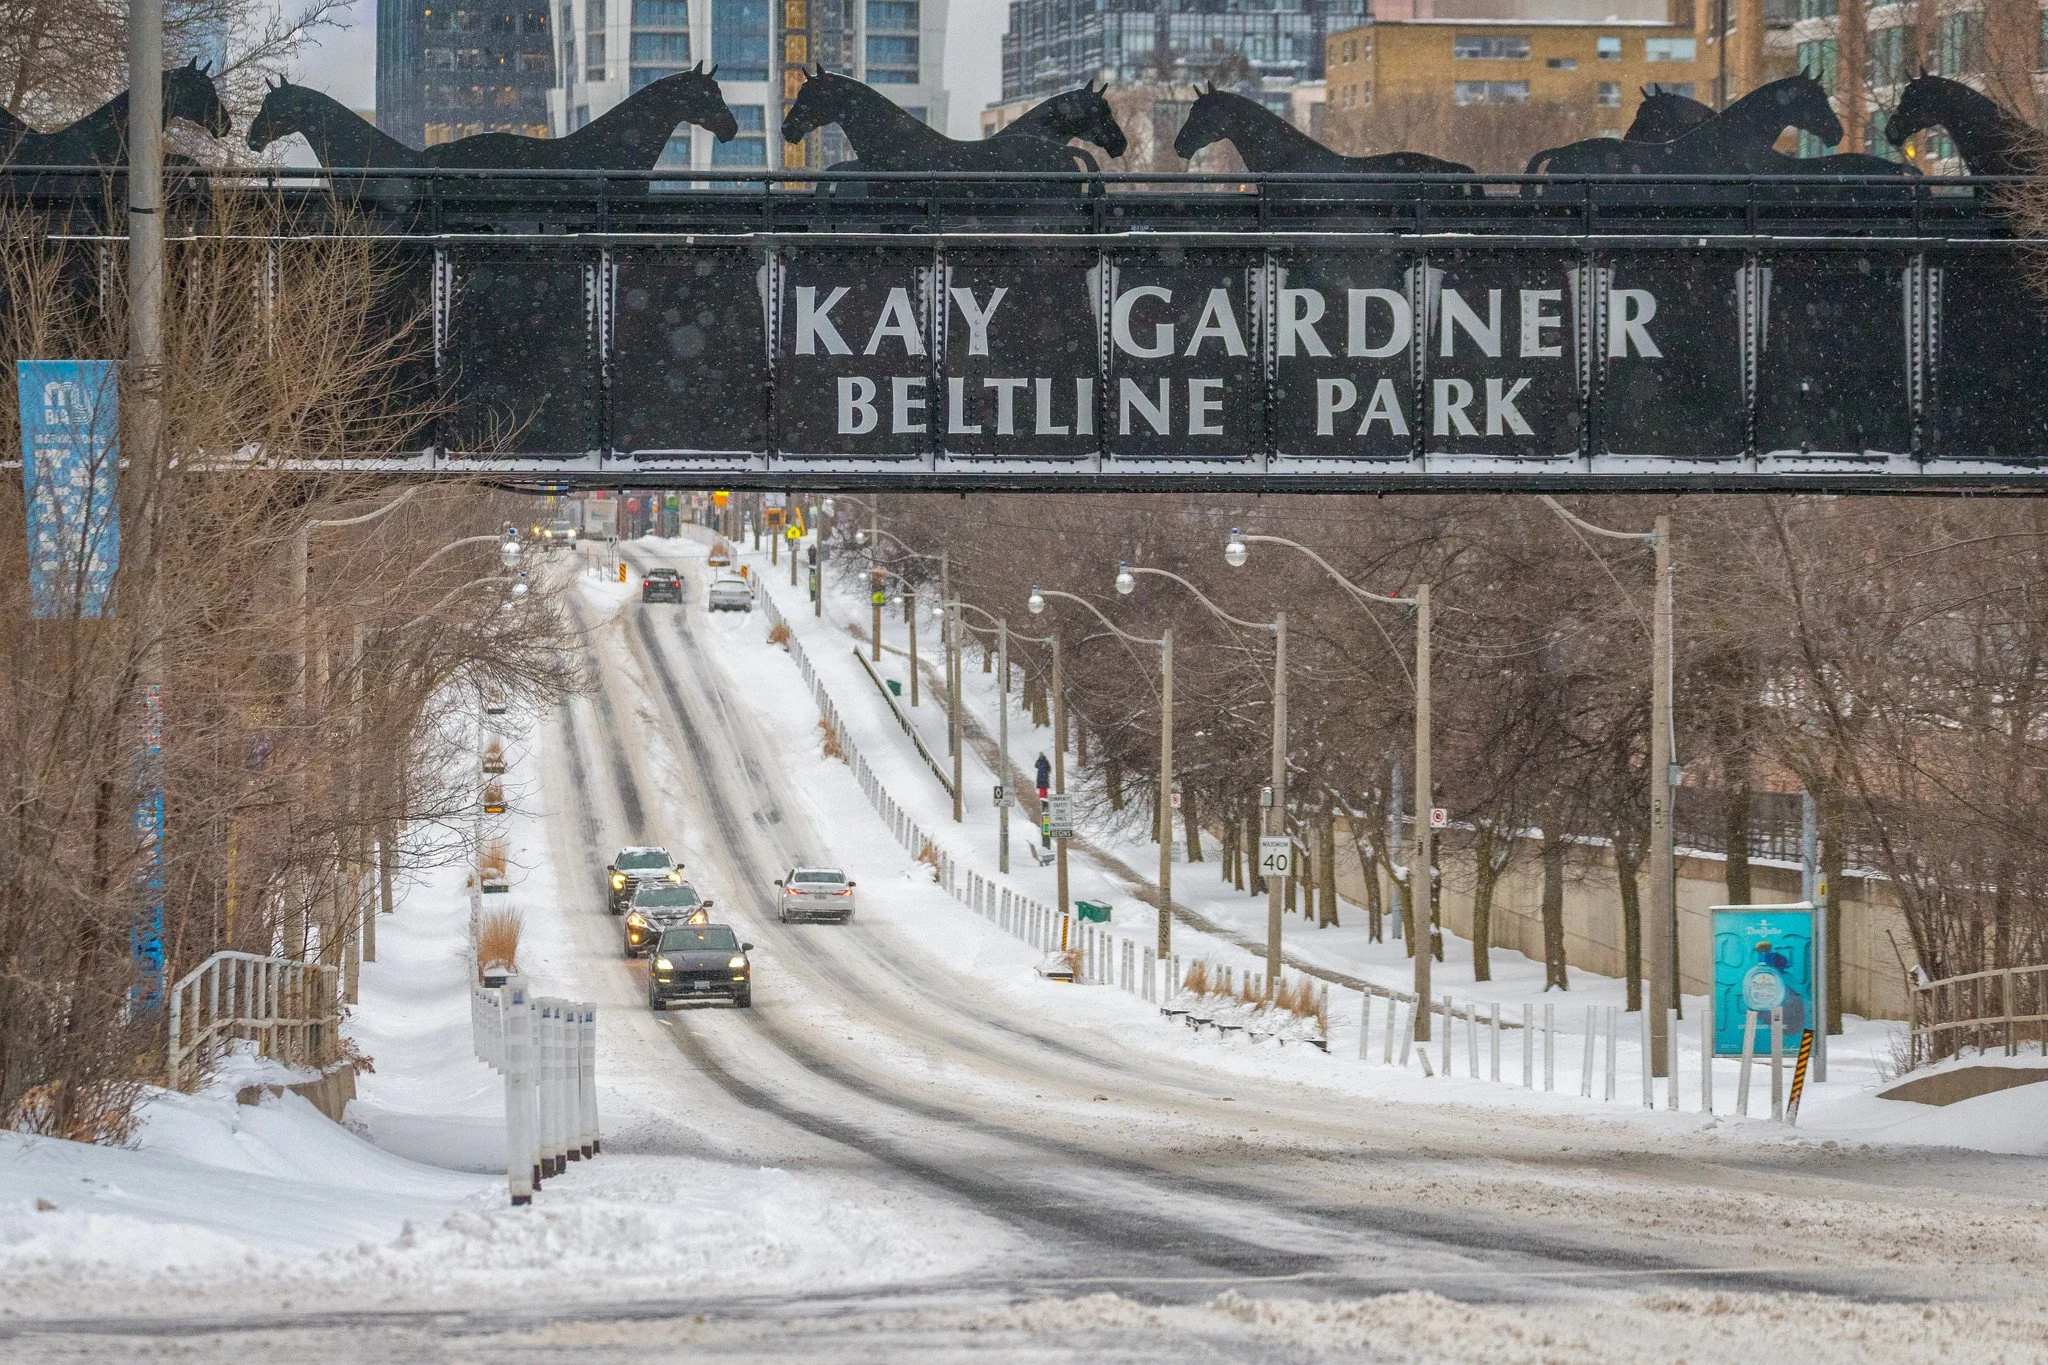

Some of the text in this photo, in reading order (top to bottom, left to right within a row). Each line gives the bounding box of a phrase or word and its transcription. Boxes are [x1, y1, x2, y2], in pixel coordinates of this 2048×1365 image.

[795, 286, 1664, 358] KAY GARDNER
[837, 376, 1536, 436] BELTLINE PARK
[1263, 854, 1288, 871] 40
